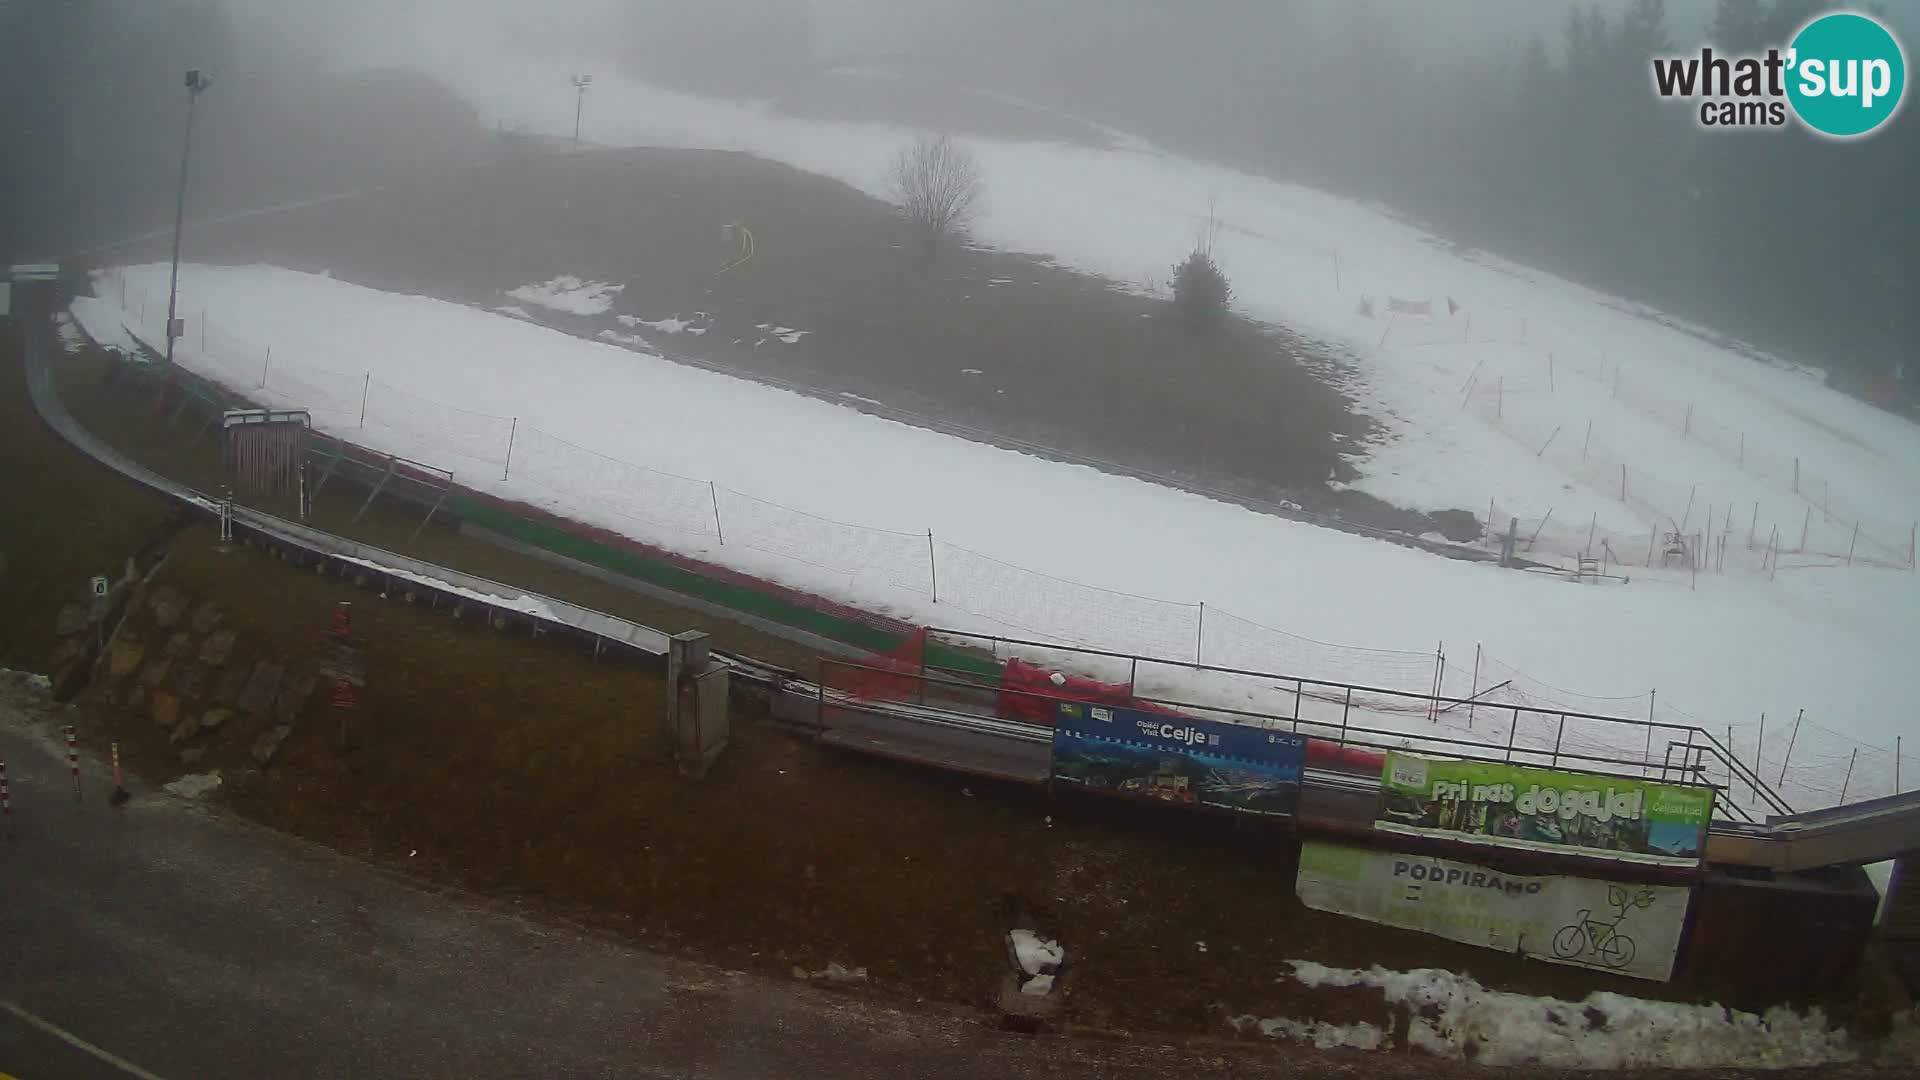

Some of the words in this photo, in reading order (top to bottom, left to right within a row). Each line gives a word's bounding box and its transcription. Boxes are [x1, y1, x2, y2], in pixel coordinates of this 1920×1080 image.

[1141, 728, 1159, 738] Visit
[1160, 724, 1206, 746] Celje
[1470, 783, 1514, 804] nas
[1515, 785, 1645, 823] dogaja!
[1393, 861, 1542, 894] PODPIRAMO
